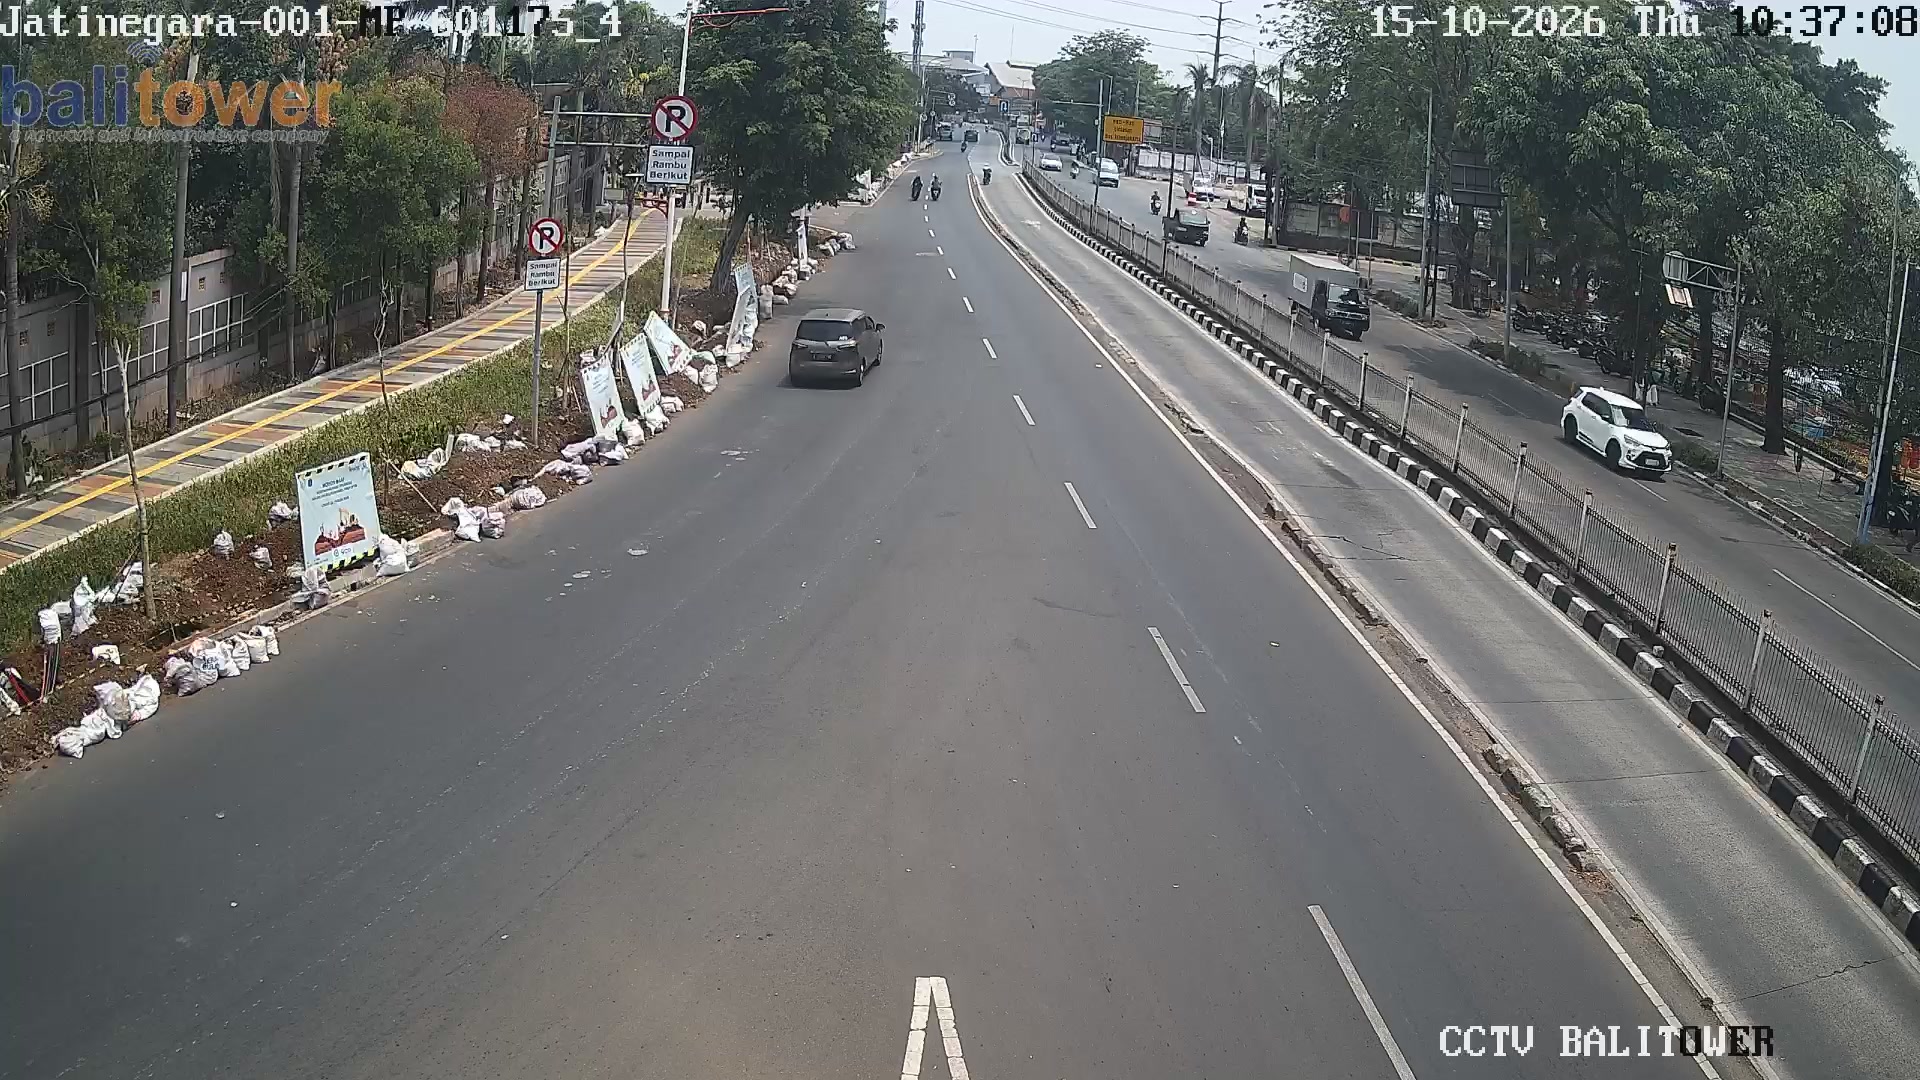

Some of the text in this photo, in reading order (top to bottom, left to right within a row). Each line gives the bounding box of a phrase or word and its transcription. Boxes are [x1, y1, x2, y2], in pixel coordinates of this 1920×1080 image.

[652, 149, 691, 159] Sampai
[652, 160, 687, 170] Rambu
[649, 171, 688, 180] Berikut
[529, 261, 558, 270] Sampai
[530, 271, 555, 279] Rambu
[528, 279, 556, 287] Berikut
